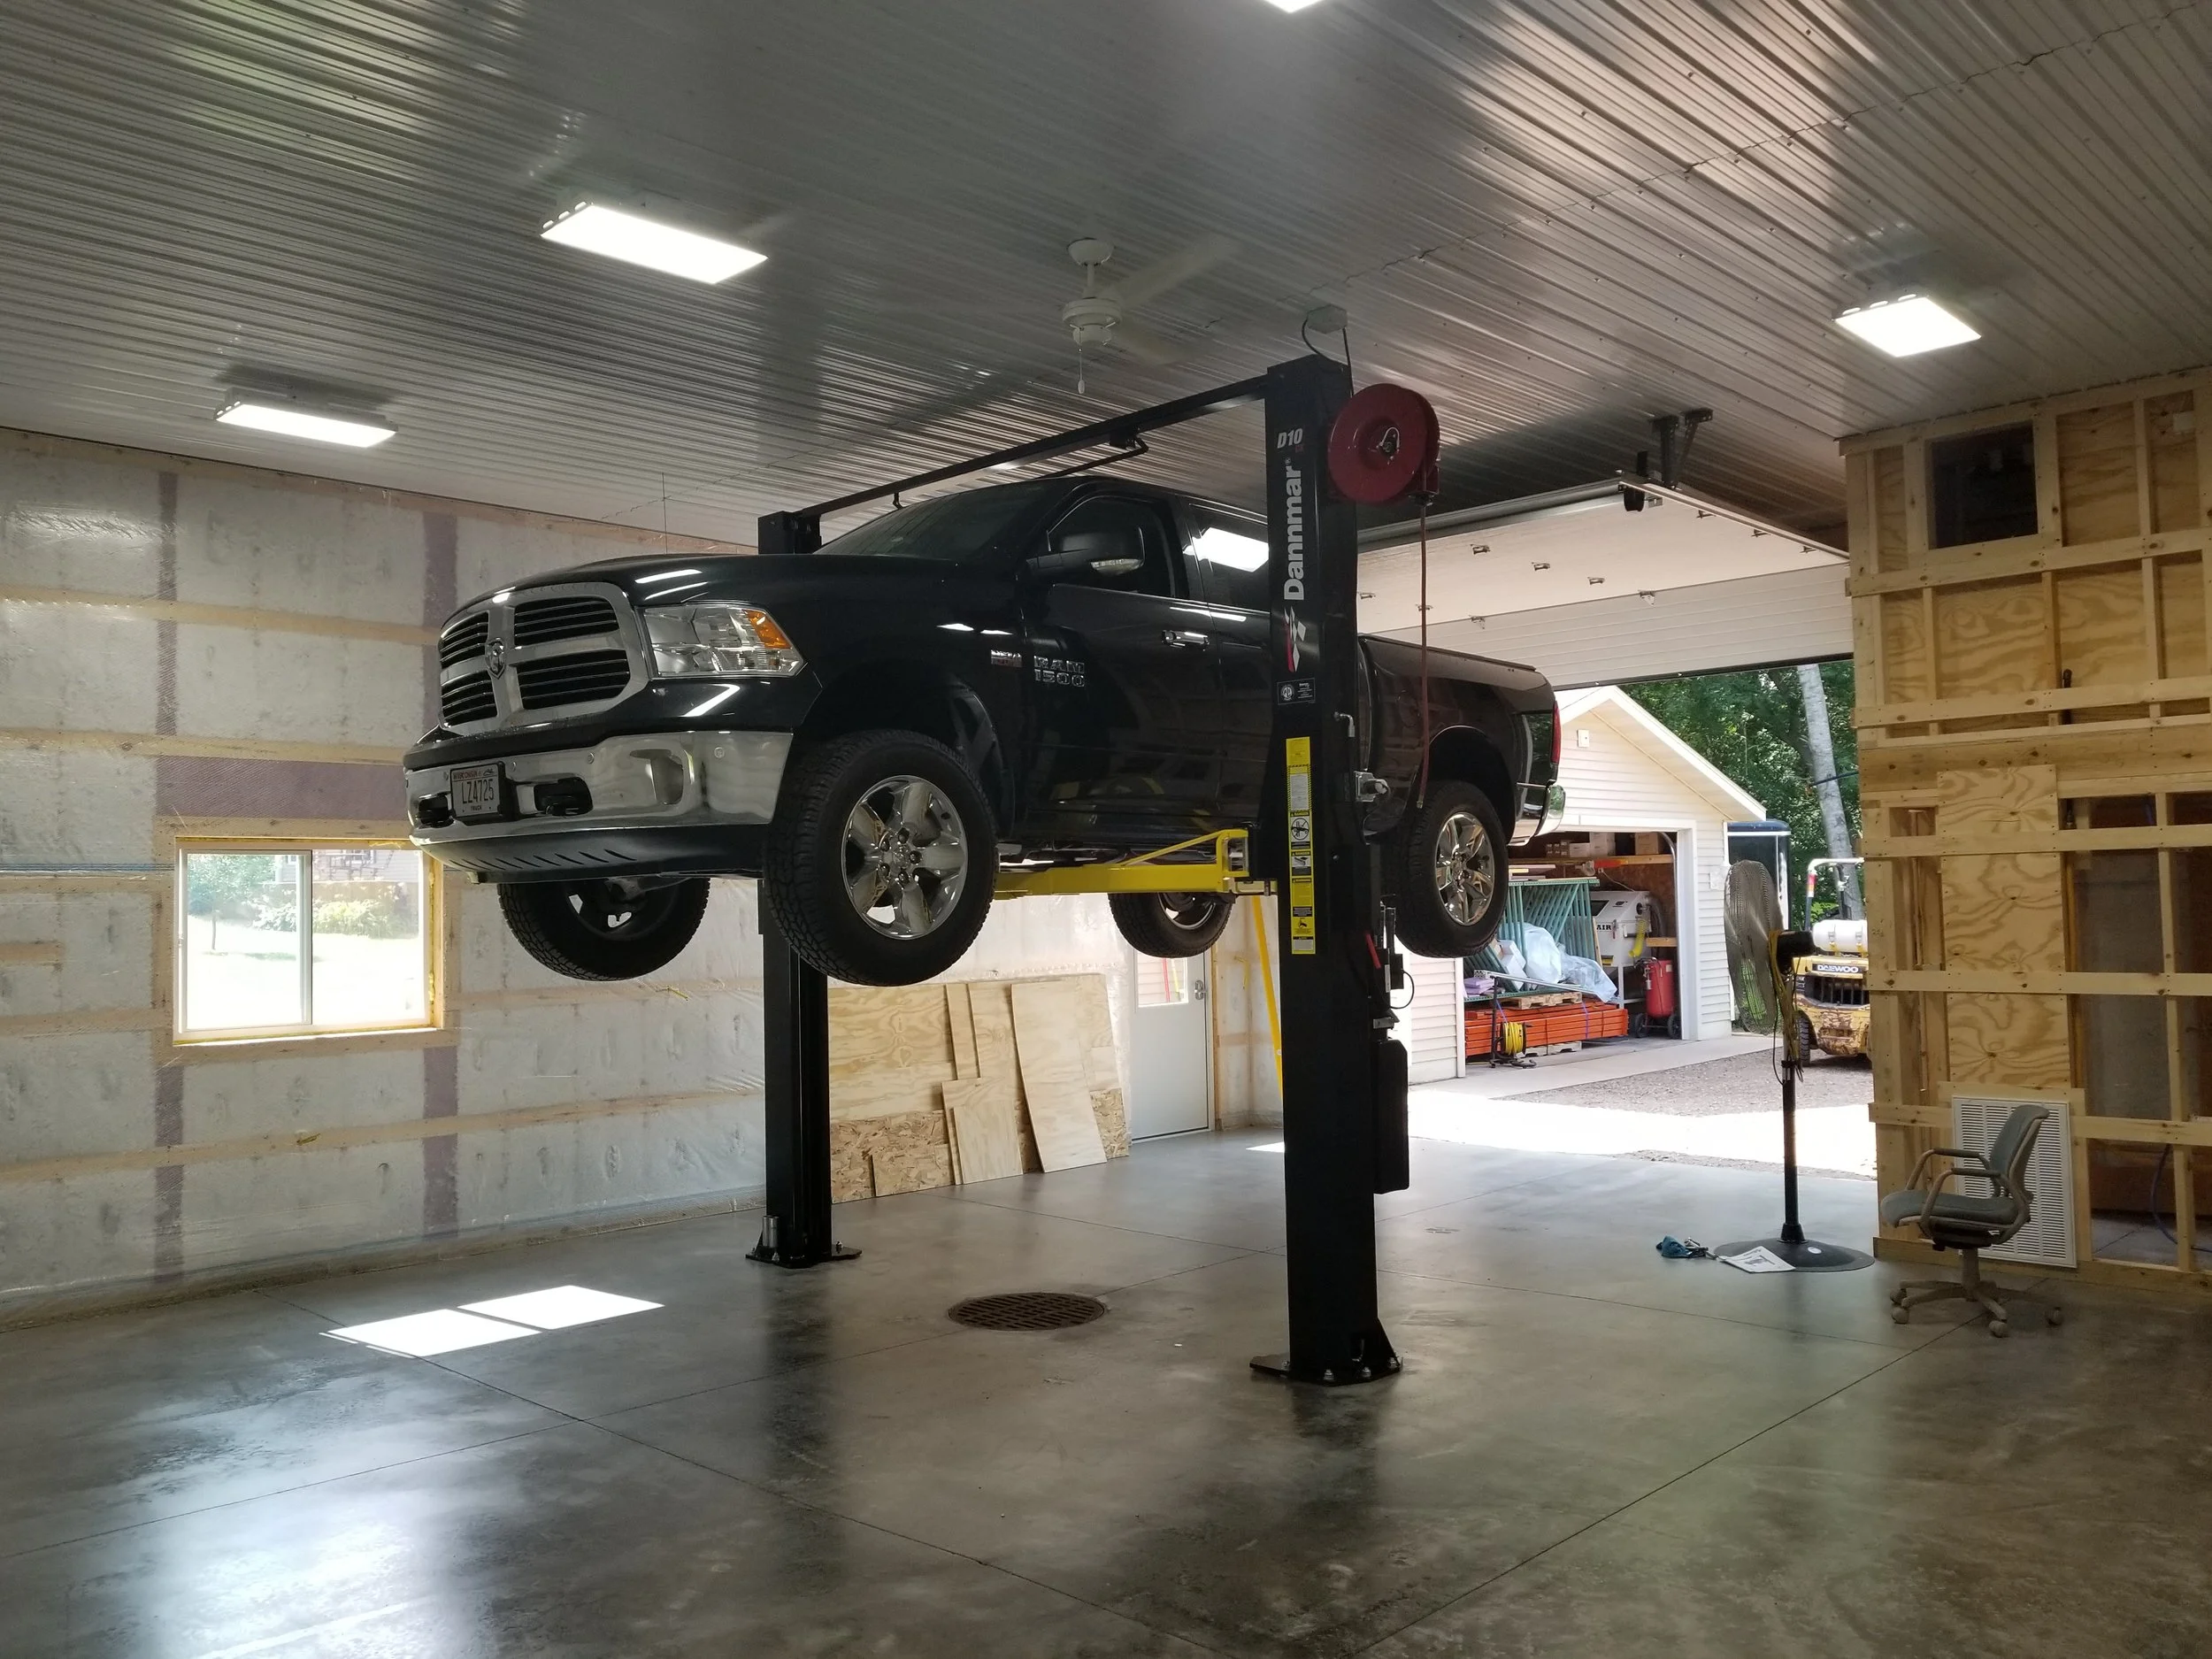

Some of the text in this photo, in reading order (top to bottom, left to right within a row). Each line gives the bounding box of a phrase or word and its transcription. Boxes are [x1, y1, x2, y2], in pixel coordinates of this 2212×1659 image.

[1277, 428, 1303, 449] D10
[1284, 465, 1304, 600] Dannmar
[1033, 655, 1086, 674] RAM
[1033, 669, 1086, 687] 1500
[462, 779, 494, 803] LZ4725
[1816, 964, 1859, 973] DAEWOO
